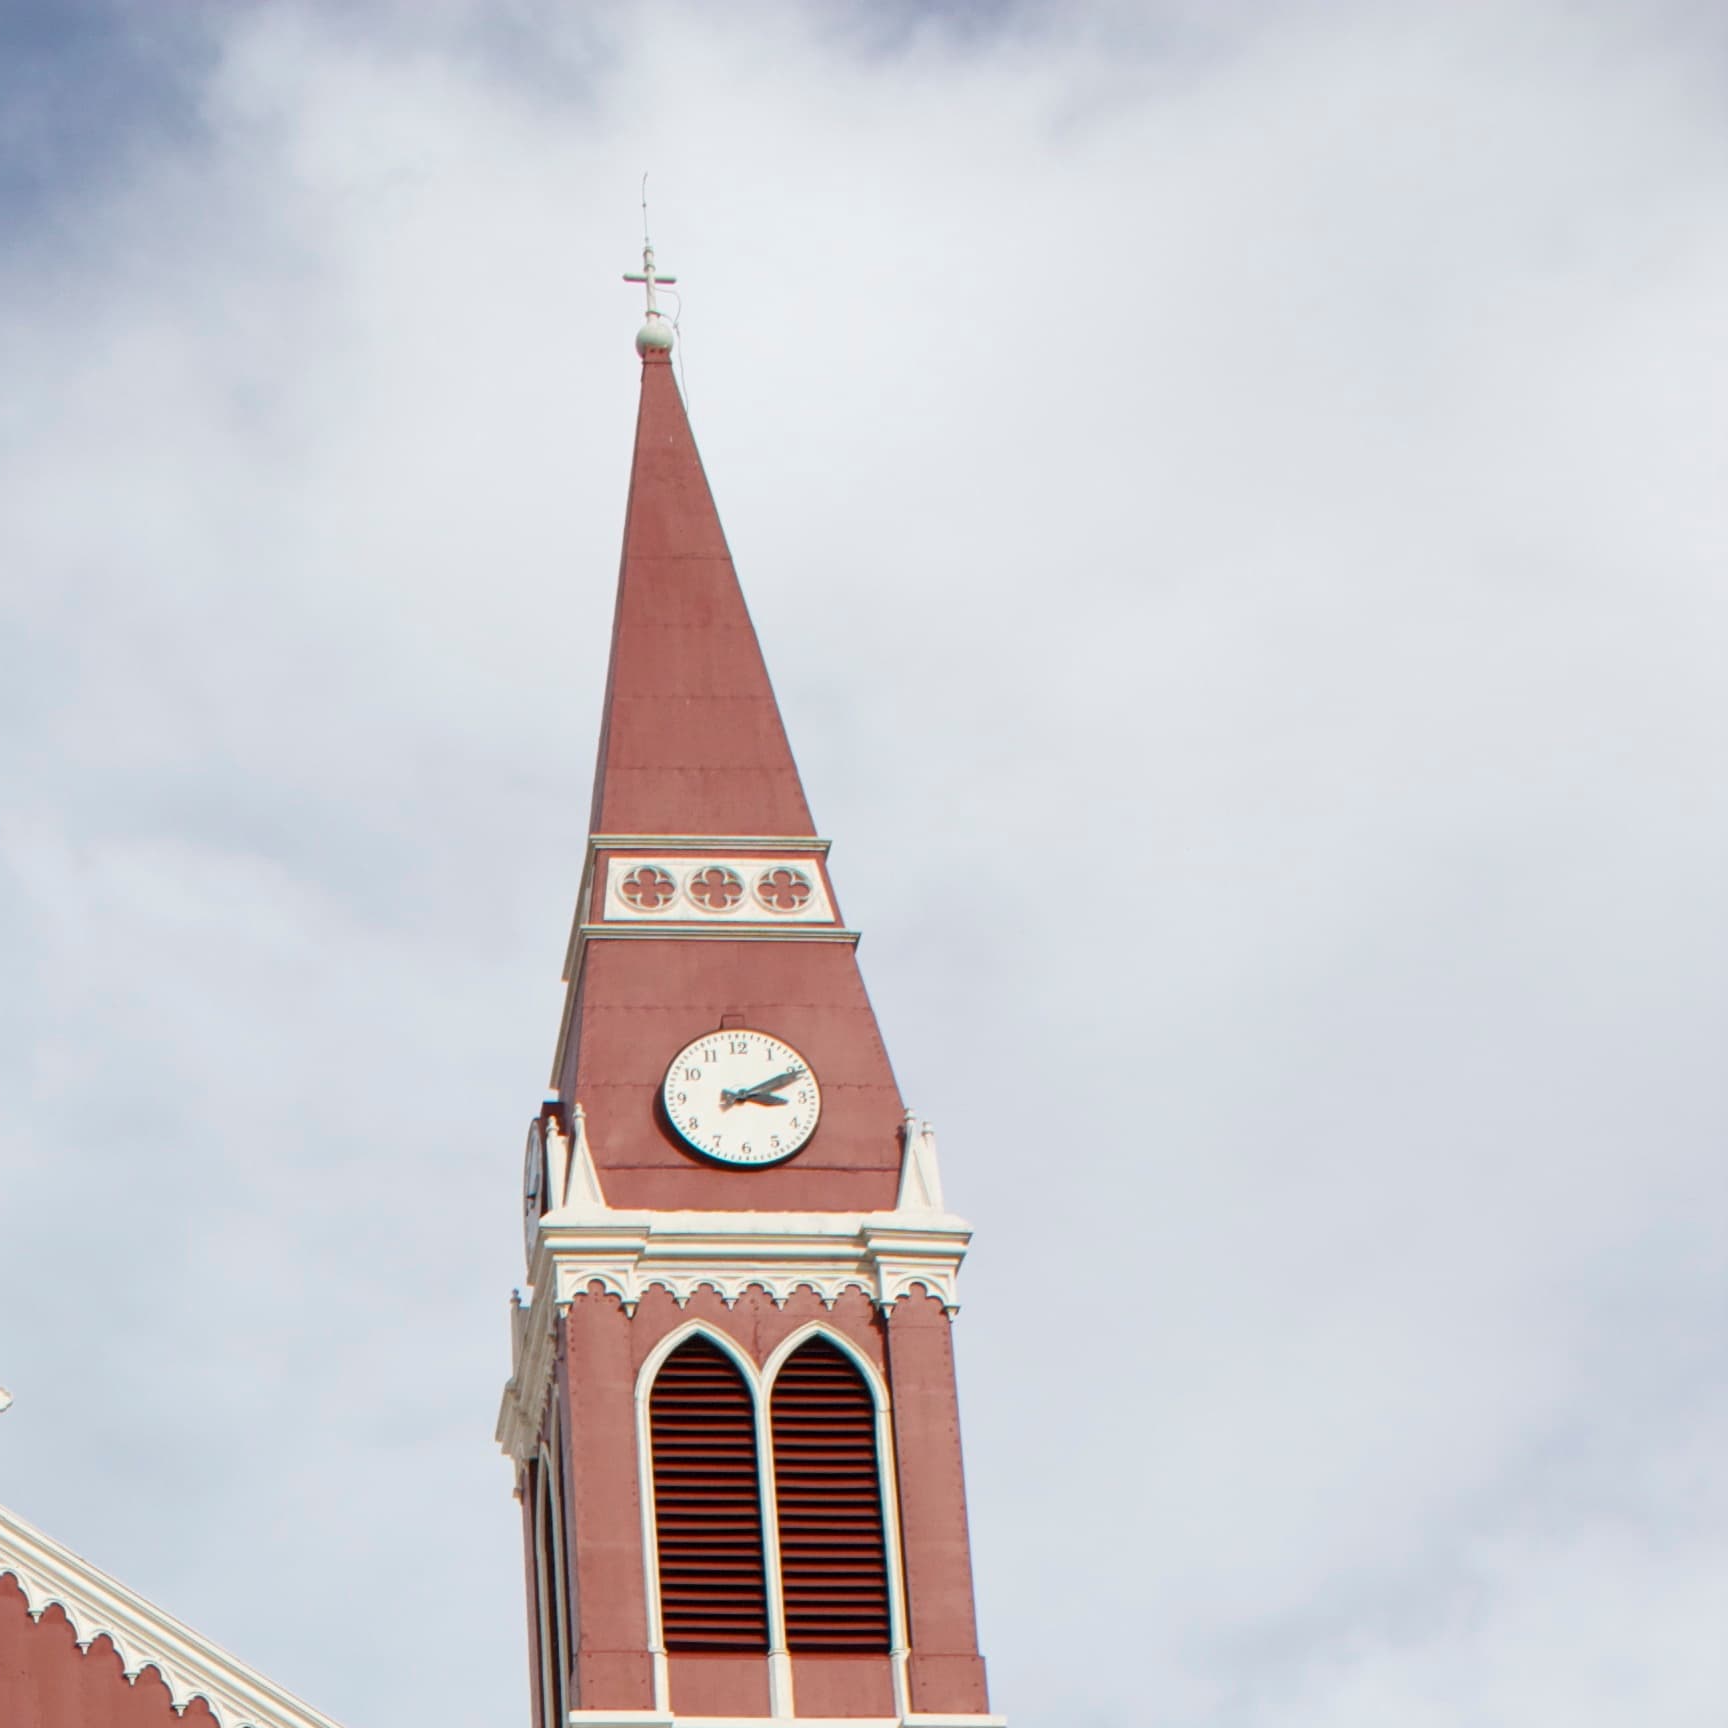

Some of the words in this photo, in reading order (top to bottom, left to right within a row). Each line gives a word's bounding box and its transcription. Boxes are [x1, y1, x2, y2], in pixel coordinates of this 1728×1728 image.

[729, 1041, 748, 1055] 12
[766, 1047, 774, 1061] 1
[704, 1049, 718, 1063] 11
[684, 1067, 702, 1081] 10
[676, 1092, 687, 1105] 9
[797, 1091, 807, 1105] 3
[688, 1116, 699, 1130] 8
[789, 1116, 801, 1129] 4
[712, 1135, 722, 1149] 7
[741, 1142, 752, 1154] 6
[770, 1135, 780, 1148] 5
